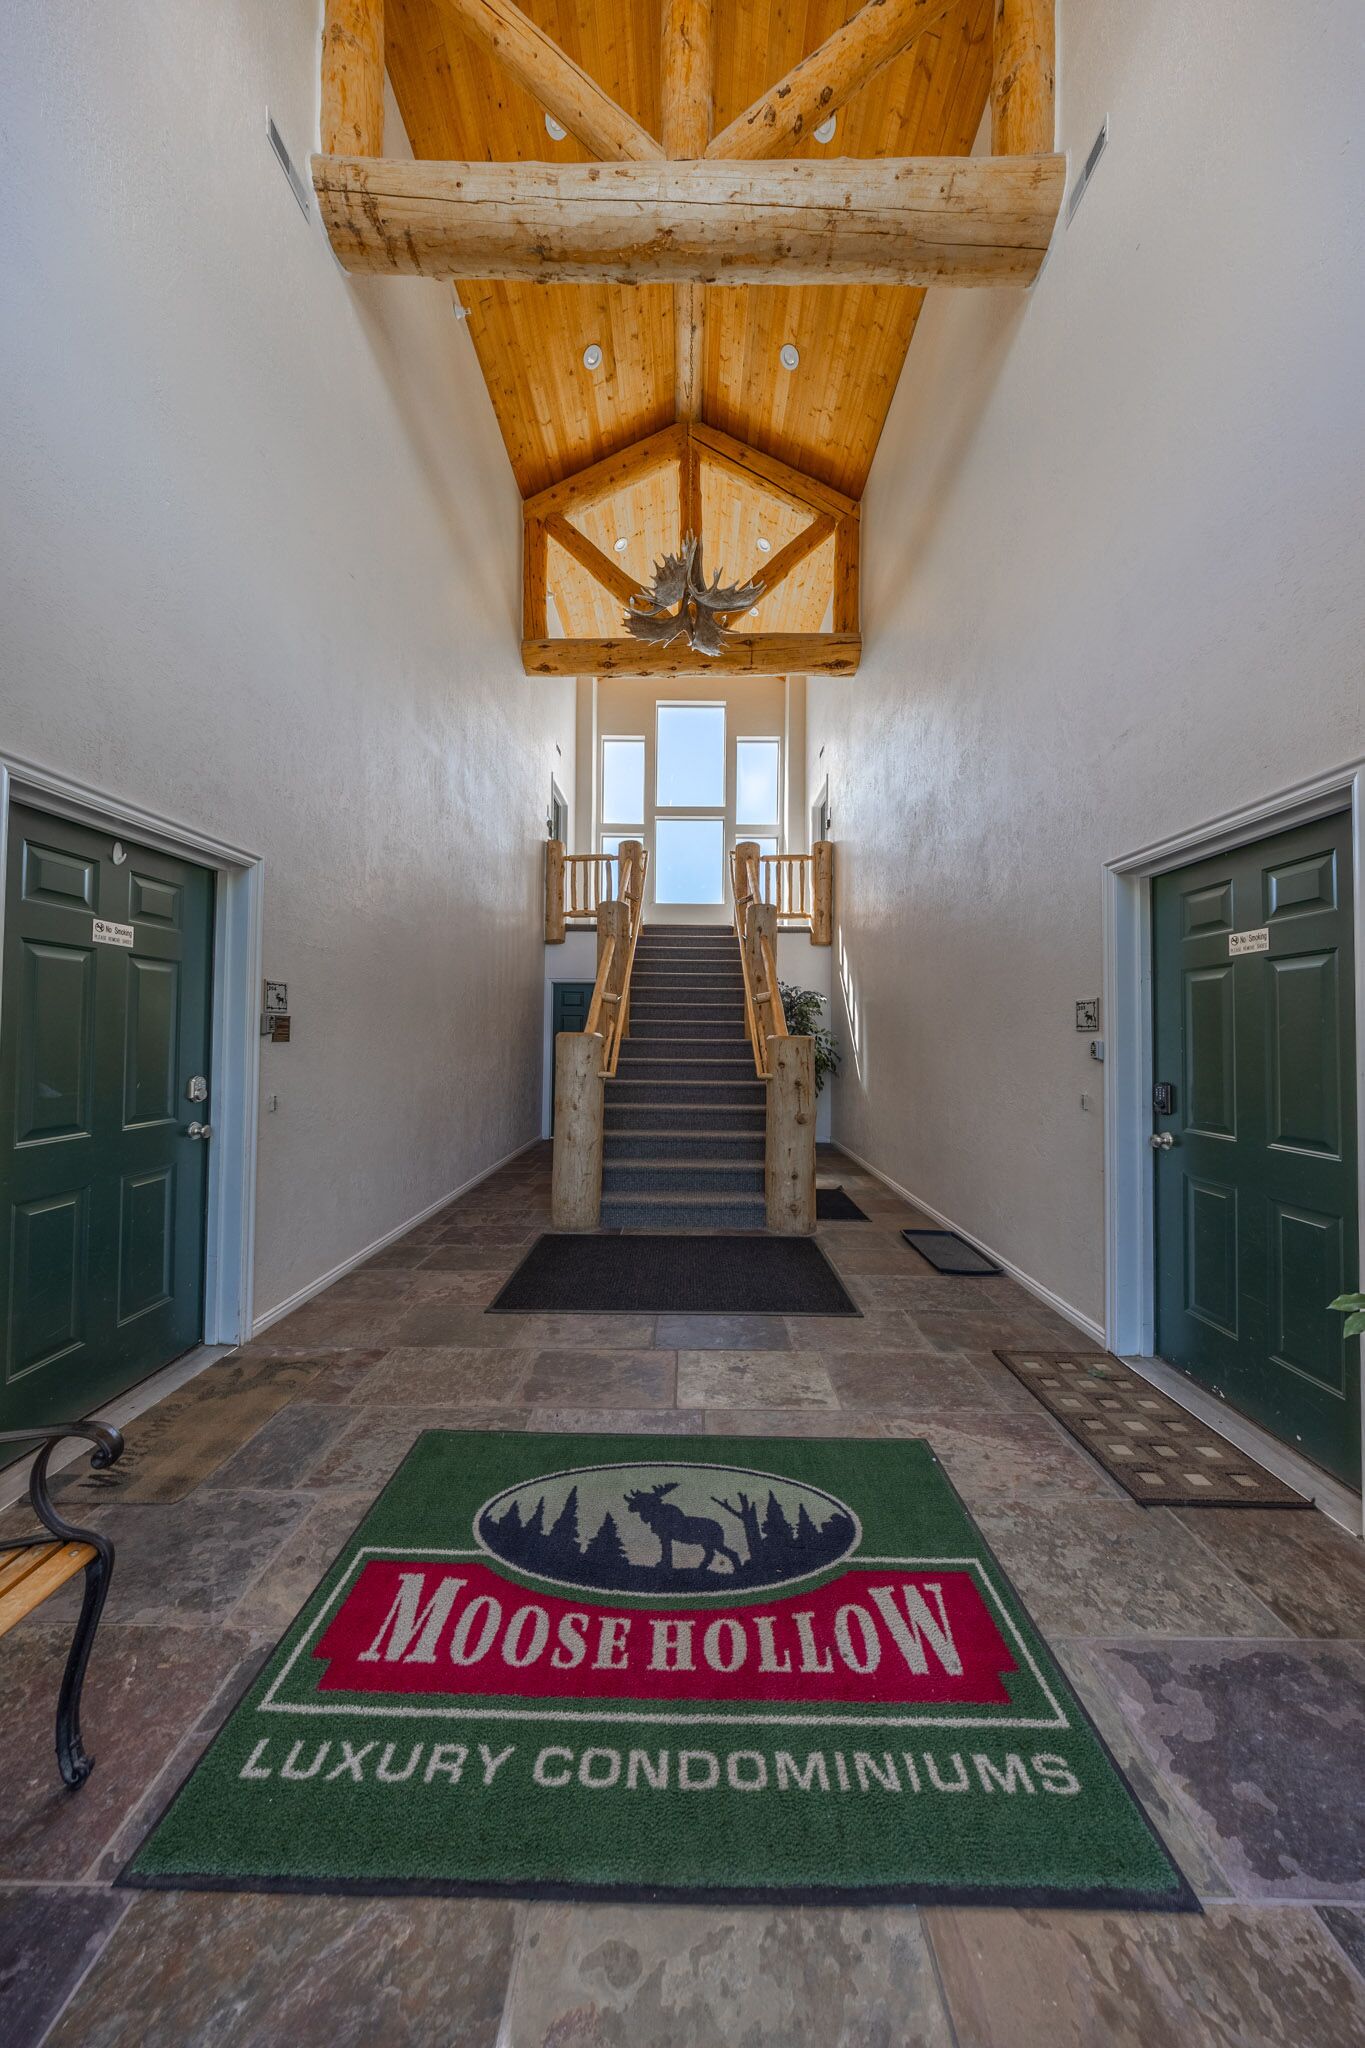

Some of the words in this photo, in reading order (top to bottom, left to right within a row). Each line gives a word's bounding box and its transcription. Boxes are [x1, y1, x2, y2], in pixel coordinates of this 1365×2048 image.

[106, 926, 113, 934] No
[114, 927, 132, 938] Smoking
[1248, 932, 1268, 943] Smoking
[358, 1572, 632, 1671] MOOSE
[648, 1582, 964, 1677] HOLLOW
[238, 1738, 517, 1787] LUXURY
[532, 1745, 1083, 1797] CONDOMINIUMS
